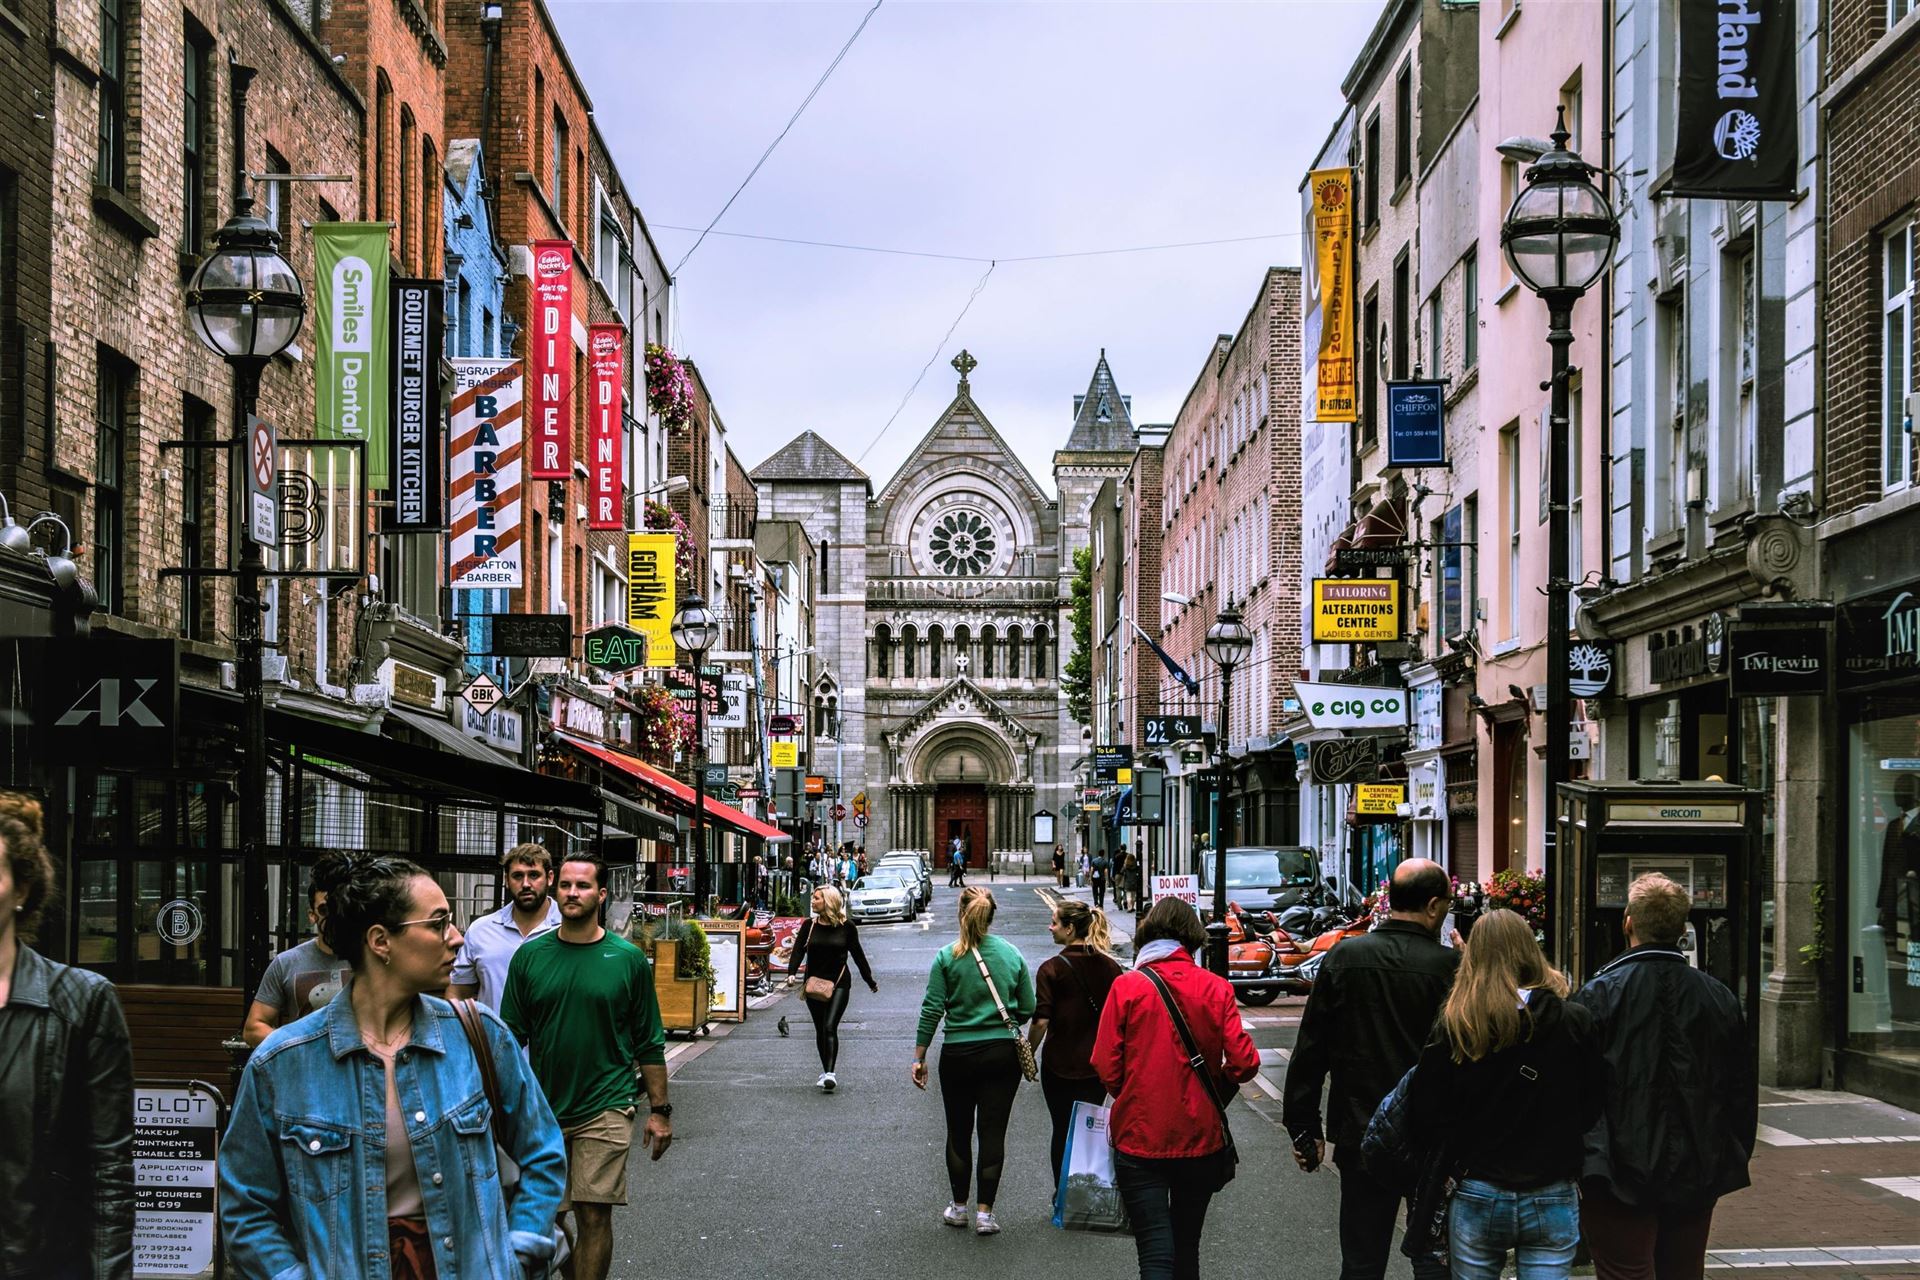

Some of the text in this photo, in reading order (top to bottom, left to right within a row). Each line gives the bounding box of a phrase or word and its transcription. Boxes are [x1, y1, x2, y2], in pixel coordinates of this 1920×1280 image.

[342, 269, 363, 344] Smiles
[466, 366, 518, 377] GRAFTON
[467, 379, 513, 389] BARBER
[543, 306, 560, 470] DINER
[342, 358, 363, 439] Dental
[402, 288, 423, 524] GOURMET BURGER KITCHEN
[1394, 402, 1437, 412] CHIFFON
[598, 380, 614, 522] DINER
[473, 395, 500, 559] BARBER
[465, 560, 517, 570] GRAFTON
[467, 573, 512, 582] BARBER
[631, 550, 667, 620] GOTHAM
[1328, 587, 1387, 598] TAILORING
[1322, 604, 1394, 615] ALTERATIONS
[1337, 617, 1378, 628] CENTRE
[1321, 630, 1393, 638] LADIES & GENTS
[588, 635, 642, 665] EAT
[471, 688, 494, 700] GBK
[54, 678, 165, 727] AK
[1312, 698, 1400, 719] e cig co
[1105, 746, 1116, 754] Let
[1159, 877, 1189, 889] DO NOT
[1177, 892, 1196, 903] THIS
[172, 910, 190, 936] B
[137, 1097, 207, 1113] GLOT
[166, 1174, 190, 1182] €14
